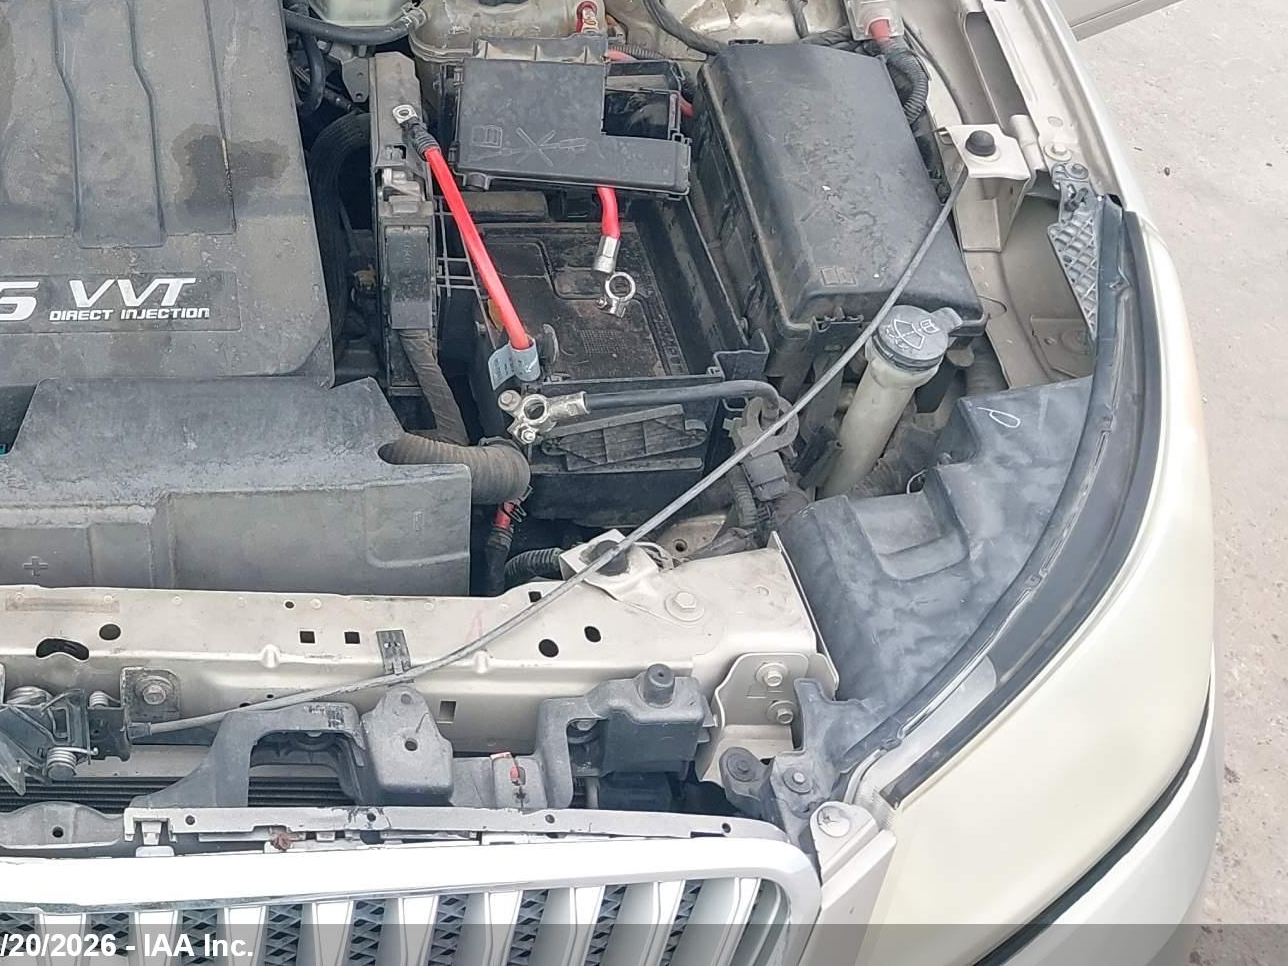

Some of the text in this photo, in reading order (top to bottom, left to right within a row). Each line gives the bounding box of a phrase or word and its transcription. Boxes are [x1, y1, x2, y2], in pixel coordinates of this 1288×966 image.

[69, 278, 196, 307] VVT
[49, 307, 210, 321] DIRECT INJECTION
